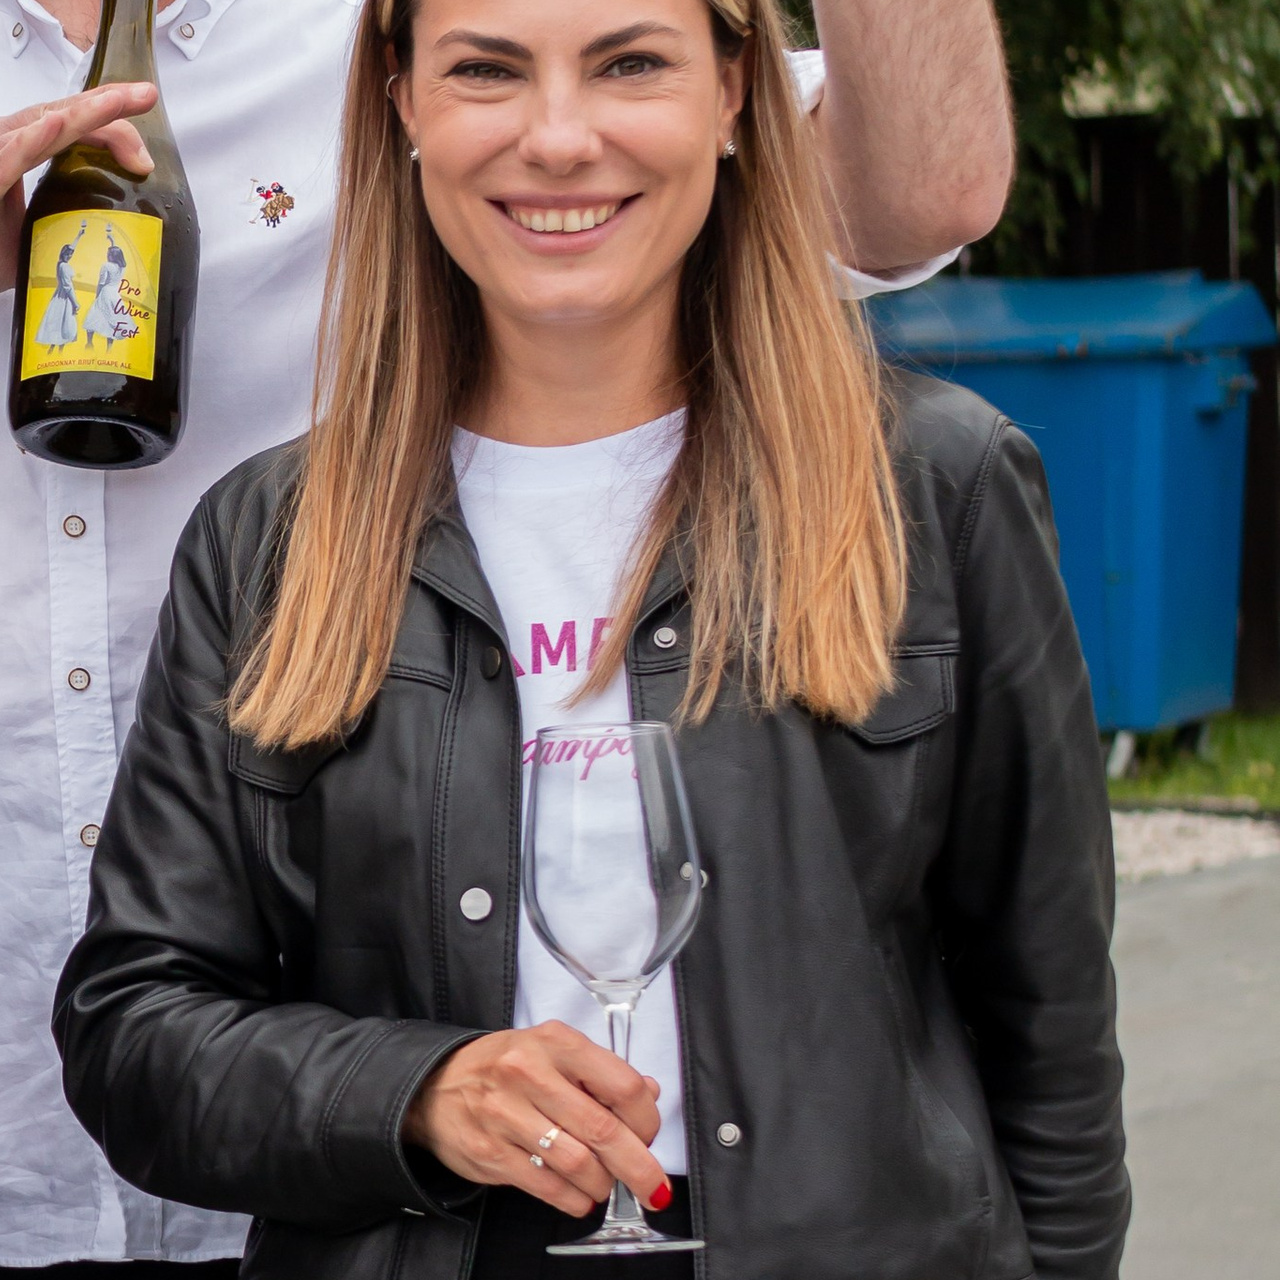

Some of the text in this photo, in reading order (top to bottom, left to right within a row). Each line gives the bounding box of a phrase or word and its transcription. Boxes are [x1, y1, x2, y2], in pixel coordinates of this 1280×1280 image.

[117, 278, 142, 296] Pro
[113, 298, 151, 320] Wine
[112, 321, 140, 339] Fest
[36, 360, 76, 371] CHARDONNAY
[97, 359, 119, 369] GRAPE
[120, 361, 133, 370] ALE
